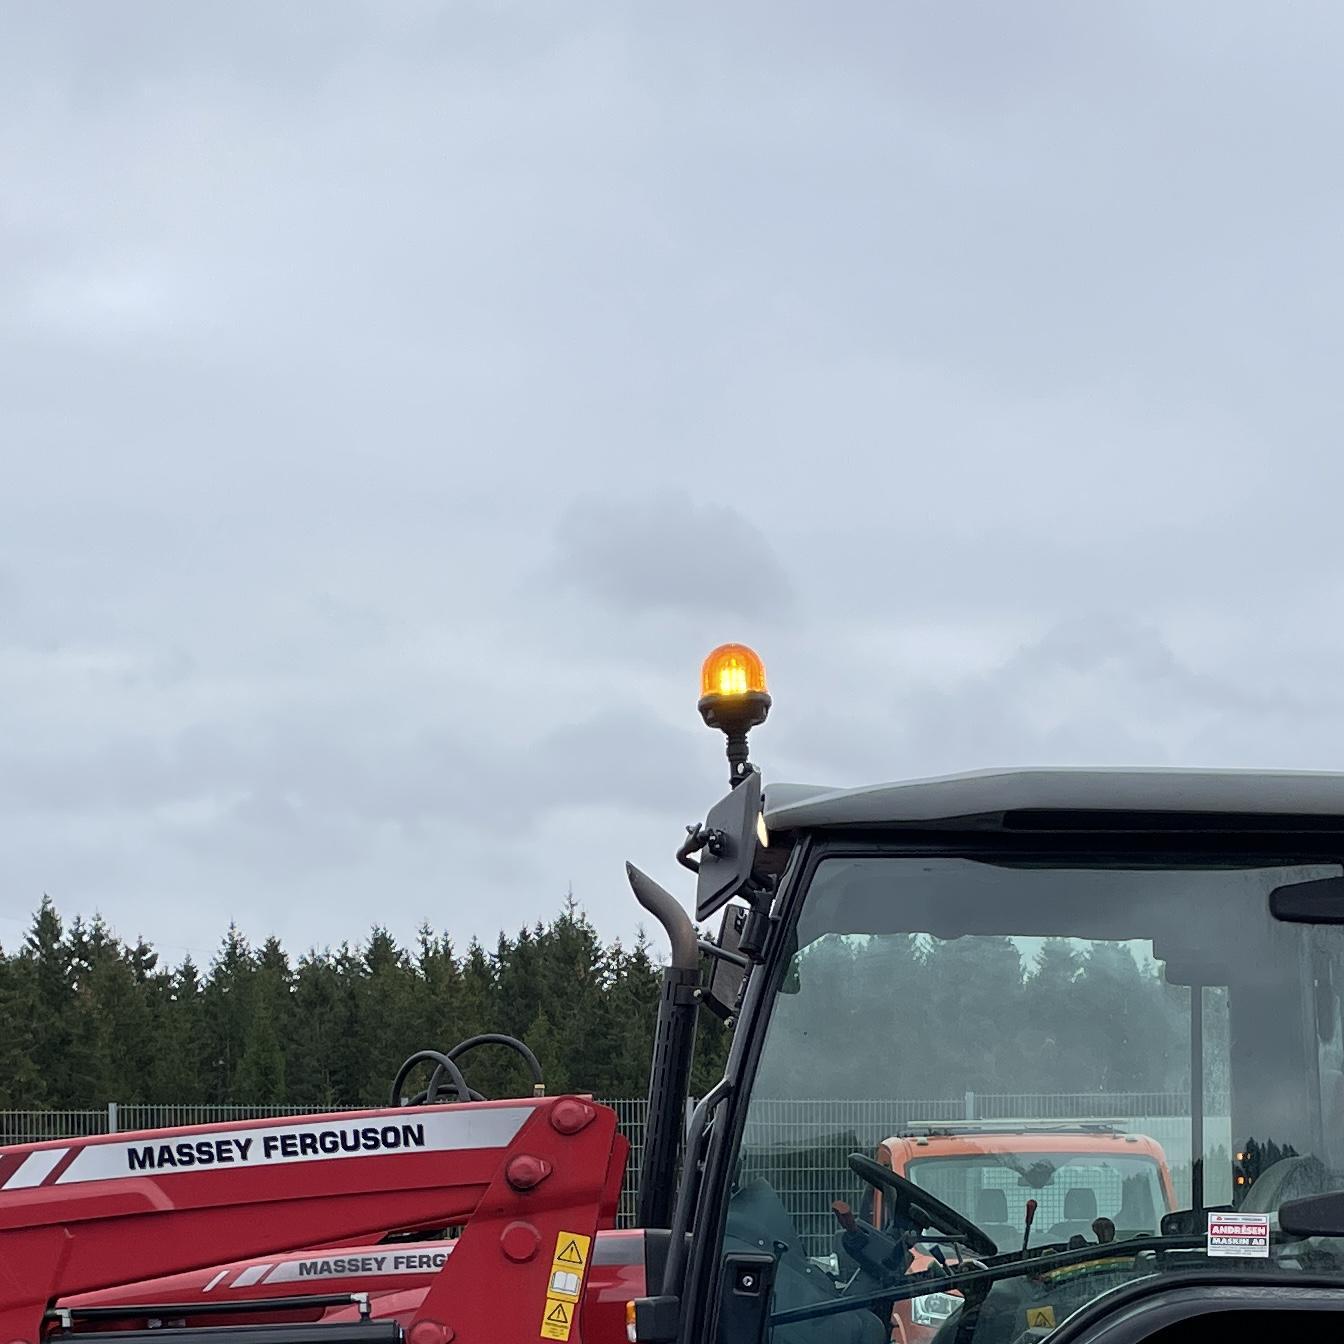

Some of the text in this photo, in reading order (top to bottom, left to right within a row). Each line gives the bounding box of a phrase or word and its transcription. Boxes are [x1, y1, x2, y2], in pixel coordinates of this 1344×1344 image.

[127, 1124, 425, 1170] MASSEY FERGUSON
[1211, 1237, 1250, 1245] MASKIN
[298, 1253, 449, 1277] MASSEY FERG
